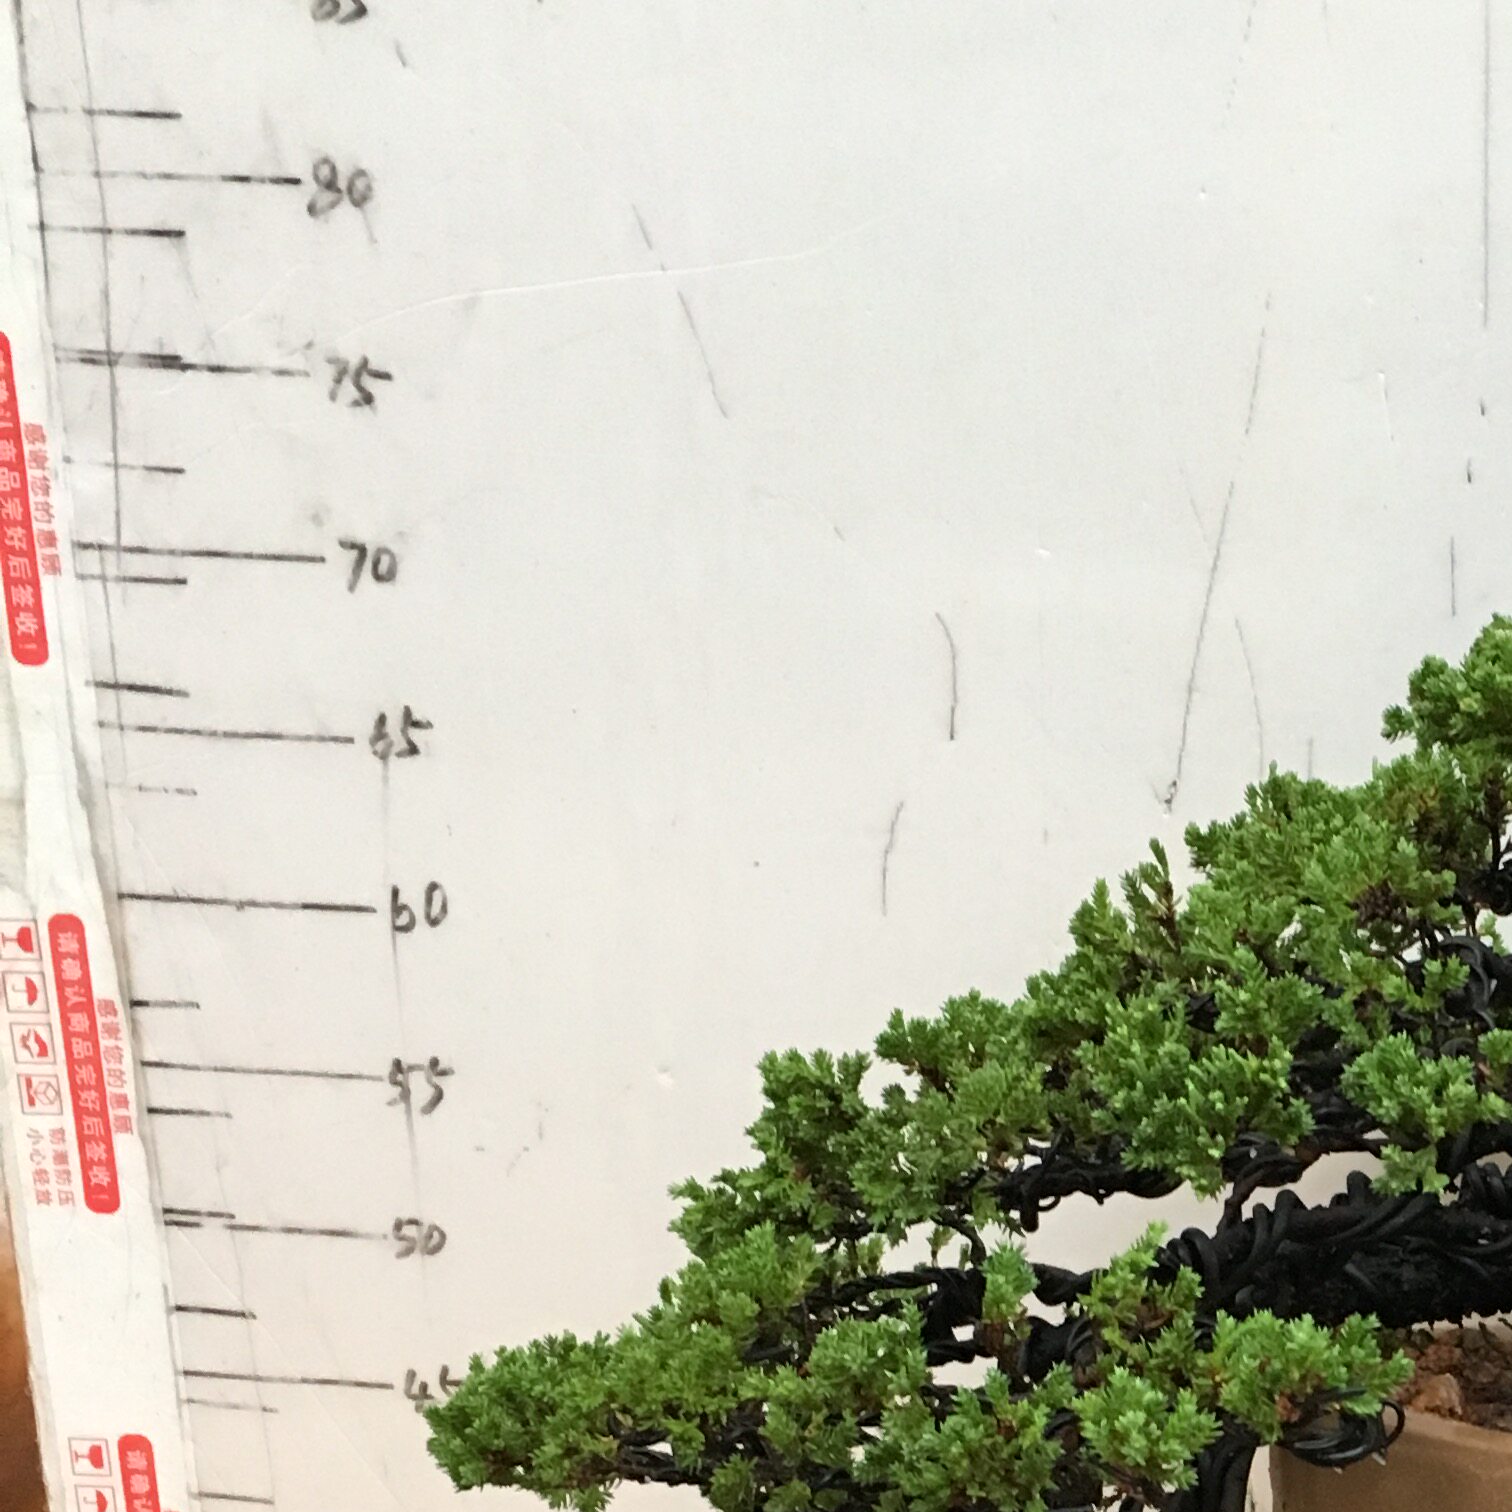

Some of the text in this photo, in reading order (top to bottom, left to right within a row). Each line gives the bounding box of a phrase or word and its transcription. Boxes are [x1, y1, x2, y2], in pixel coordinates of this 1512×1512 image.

[326, 355, 393, 407] 75
[338, 539, 397, 593] 70
[369, 705, 434, 760] 65
[391, 880, 448, 933] 60
[386, 1056, 455, 1114] 55
[392, 1217, 447, 1259] 50
